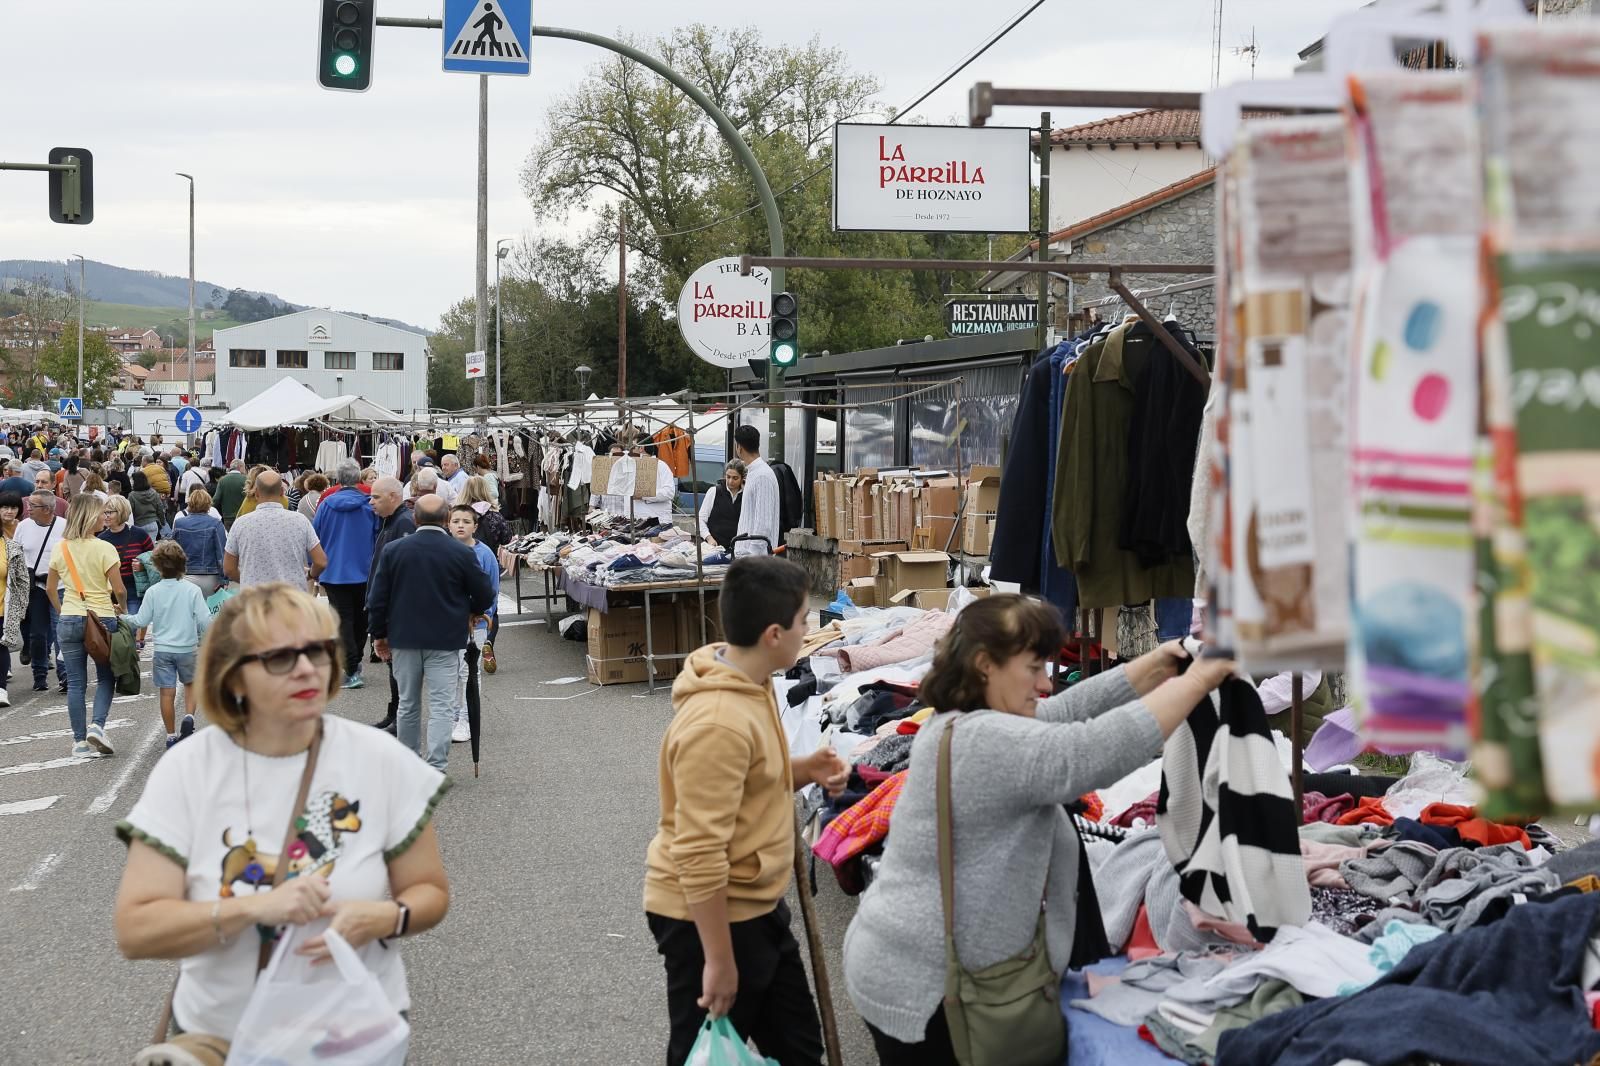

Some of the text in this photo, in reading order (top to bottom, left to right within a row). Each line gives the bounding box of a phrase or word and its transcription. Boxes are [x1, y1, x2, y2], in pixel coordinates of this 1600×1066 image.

[880, 136, 905, 161] LA
[896, 189, 982, 201] DE HOZNAYO
[717, 263, 769, 286] TERAZA
[695, 281, 714, 299] LA
[953, 303, 1039, 321] RESTAURANT
[951, 322, 1004, 334] MIZMAYA
[713, 348, 757, 360] Desde 1972
